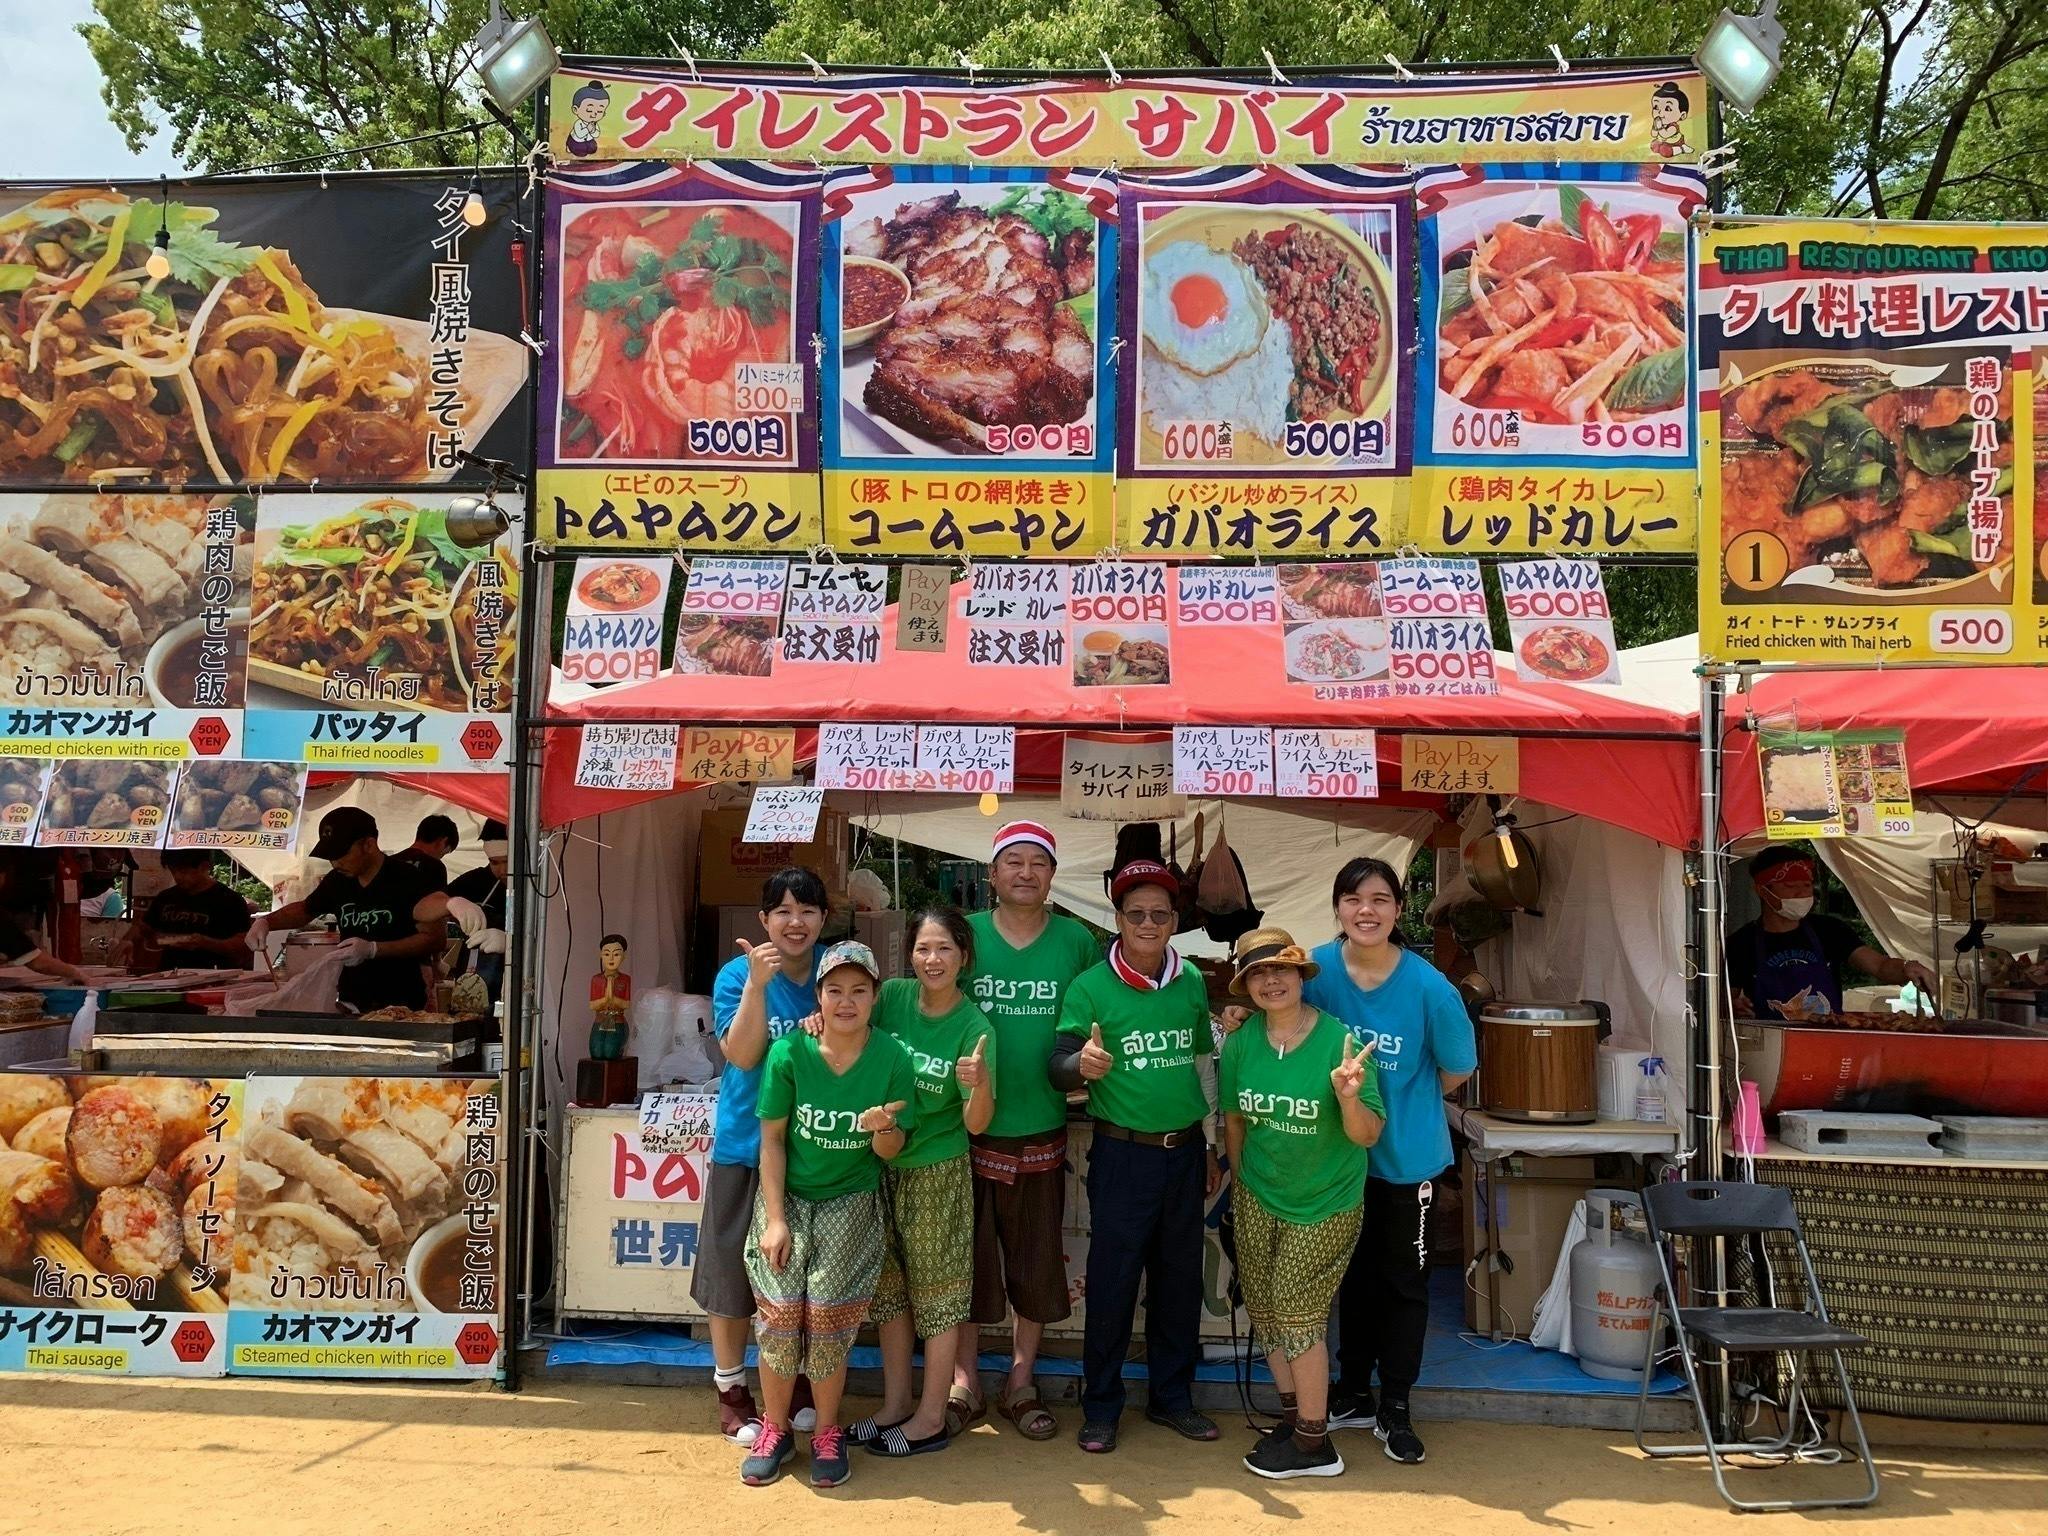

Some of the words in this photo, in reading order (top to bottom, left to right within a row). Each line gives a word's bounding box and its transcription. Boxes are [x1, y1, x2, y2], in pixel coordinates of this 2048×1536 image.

[622, 84, 1096, 157] タイレストラン
[1126, 90, 1347, 158] サバイ
[1361, 105, 1628, 145] ร้านอาหารสบาย
[1717, 247, 1785, 271] THAI
[1804, 246, 1975, 270] RESTAURANT
[427, 186, 471, 470] タイ風焼きそば
[689, 416, 786, 456] 500円
[984, 424, 1093, 453] 500円
[1285, 420, 1384, 458] 500円
[1582, 423, 1682, 449] 500円
[1967, 358, 2001, 562] 鶏のハーブ揚げ
[603, 474, 748, 498] (エビのスープ)
[850, 477, 1087, 506] (豚トロの網焼き)
[1166, 480, 1358, 506] (バジル炒めライス)
[1448, 475, 1665, 503] (鶏肉タイカレー)
[555, 494, 801, 542] トムヤムクン
[1142, 505, 1383, 550] ガパオライス
[1441, 505, 1679, 549] レッドカレー
[849, 508, 1086, 552] コームーヤン
[1749, 541, 1763, 582] 1
[689, 571, 785, 591] コームーヤン
[908, 568, 945, 594] Pay
[973, 566, 1058, 593] ガパオライス
[1071, 565, 1166, 595] ガパオライス
[1382, 571, 1481, 592] コームーヤン
[1501, 562, 1600, 591] トムヤムクン
[684, 590, 783, 612] 500円
[788, 590, 884, 613] トムヤムクン
[1179, 579, 1275, 601] レッドカレー
[194, 508, 237, 706] 鶏肉のせご飯
[910, 592, 946, 617] Pay
[964, 599, 1017, 619] レッド
[1025, 596, 1067, 621] カレー
[1071, 594, 1167, 622] 500円
[1178, 600, 1276, 623] 500円
[1384, 592, 1486, 614] 500円
[1506, 590, 1609, 618] 500円
[566, 617, 662, 651] トムヤムクン
[907, 616, 939, 631] 使え
[1390, 620, 1492, 650] ガパオライス
[1940, 619, 2004, 645] 500
[783, 623, 880, 663] 注文受付
[969, 628, 1066, 666] 注文受付
[1726, 635, 1759, 650] Fried
[1764, 635, 1815, 650] chicken
[1819, 636, 1846, 650] with
[1851, 636, 1876, 650] Thai
[1881, 636, 1912, 650] herb
[563, 648, 659, 681] 500円
[1391, 651, 1495, 680] 500円
[14, 662, 145, 697] ข้าวมันไก่
[322, 667, 420, 700] ผัดไทย
[6, 709, 158, 737] カオマンガイ
[198, 724, 221, 735] 500
[309, 712, 427, 743] パッタイ
[470, 729, 493, 740] 500
[824, 726, 864, 742] ガパオ
[876, 726, 915, 743] レッド
[198, 737, 222, 747] YEN
[469, 741, 494, 751] YEN
[690, 729, 790, 762] PayPay
[923, 728, 963, 743] ガパオ
[975, 728, 1014, 745] レッド
[1178, 729, 1218, 745] ガパオ
[1231, 729, 1271, 746] レッド
[1280, 731, 1321, 747] ガパオ
[56, 742, 117, 757] chicken
[118, 743, 148, 757] with
[153, 743, 181, 757] rice
[312, 745, 340, 758] Thai
[341, 745, 371, 759] fried
[373, 746, 424, 760] noodles
[823, 743, 852, 756] ライス
[874, 743, 910, 756] カレー
[923, 745, 952, 758] ライス
[974, 745, 1010, 758] カレー
[1177, 746, 1208, 759] ライス
[1231, 747, 1268, 760] カレー
[1280, 748, 1311, 761] ライス
[1335, 748, 1371, 761] カレー
[1414, 739, 1499, 773] PayPay
[583, 757, 617, 773] 冷凍
[622, 758, 674, 772] レッドカレー
[691, 755, 774, 779] 使えます。
[839, 755, 910, 768] ハーフセット
[939, 757, 1010, 770] ハーフセット
[1196, 759, 1269, 772] ハーフセット
[1299, 761, 1373, 774] ハーフセット
[1081, 781, 1131, 798] サバイ
[1136, 781, 1168, 798] 山形
[1203, 770, 1254, 794] 500
[1307, 773, 1358, 796] 500
[1411, 769, 1494, 791] 使えます。
[1819, 745, 1839, 814] ジャスミンライス
[8, 815, 28, 825] YEN
[10, 806, 29, 815] 500
[137, 817, 157, 827] YEN
[138, 808, 158, 818] 500
[269, 811, 288, 821] 500
[1773, 811, 1781, 821] 5
[1885, 807, 1905, 816] ALL
[268, 820, 288, 829] YEN
[1823, 826, 1840, 834] 500
[1884, 821, 1910, 832] 500
[43, 831, 153, 845] タイ風ホンシリ焼き
[176, 832, 285, 847] タイ風ホンシリ焼き
[973, 974, 1058, 1000] สบาย
[996, 1003, 1056, 1015] Thailand
[1120, 1027, 1194, 1056] สบาย
[1150, 1053, 1195, 1069] Thailand
[1238, 1088, 1320, 1120] สบาย
[1261, 1116, 1318, 1136] Thailand
[459, 1094, 498, 1310] 鶏肉のせご飯
[270, 1263, 406, 1300] ข้าวมันไก่
[181, 1330, 205, 1341] 500
[262, 1314, 421, 1344] カオマンガイ
[464, 1331, 489, 1342] 500
[28, 1350, 59, 1364] Thai
[62, 1352, 123, 1368] sausage
[180, 1342, 205, 1353] YEN
[242, 1348, 310, 1364] Steamed
[315, 1349, 375, 1365] chicken
[379, 1350, 413, 1365] with
[417, 1351, 447, 1366] rice
[464, 1344, 490, 1355] YEN
